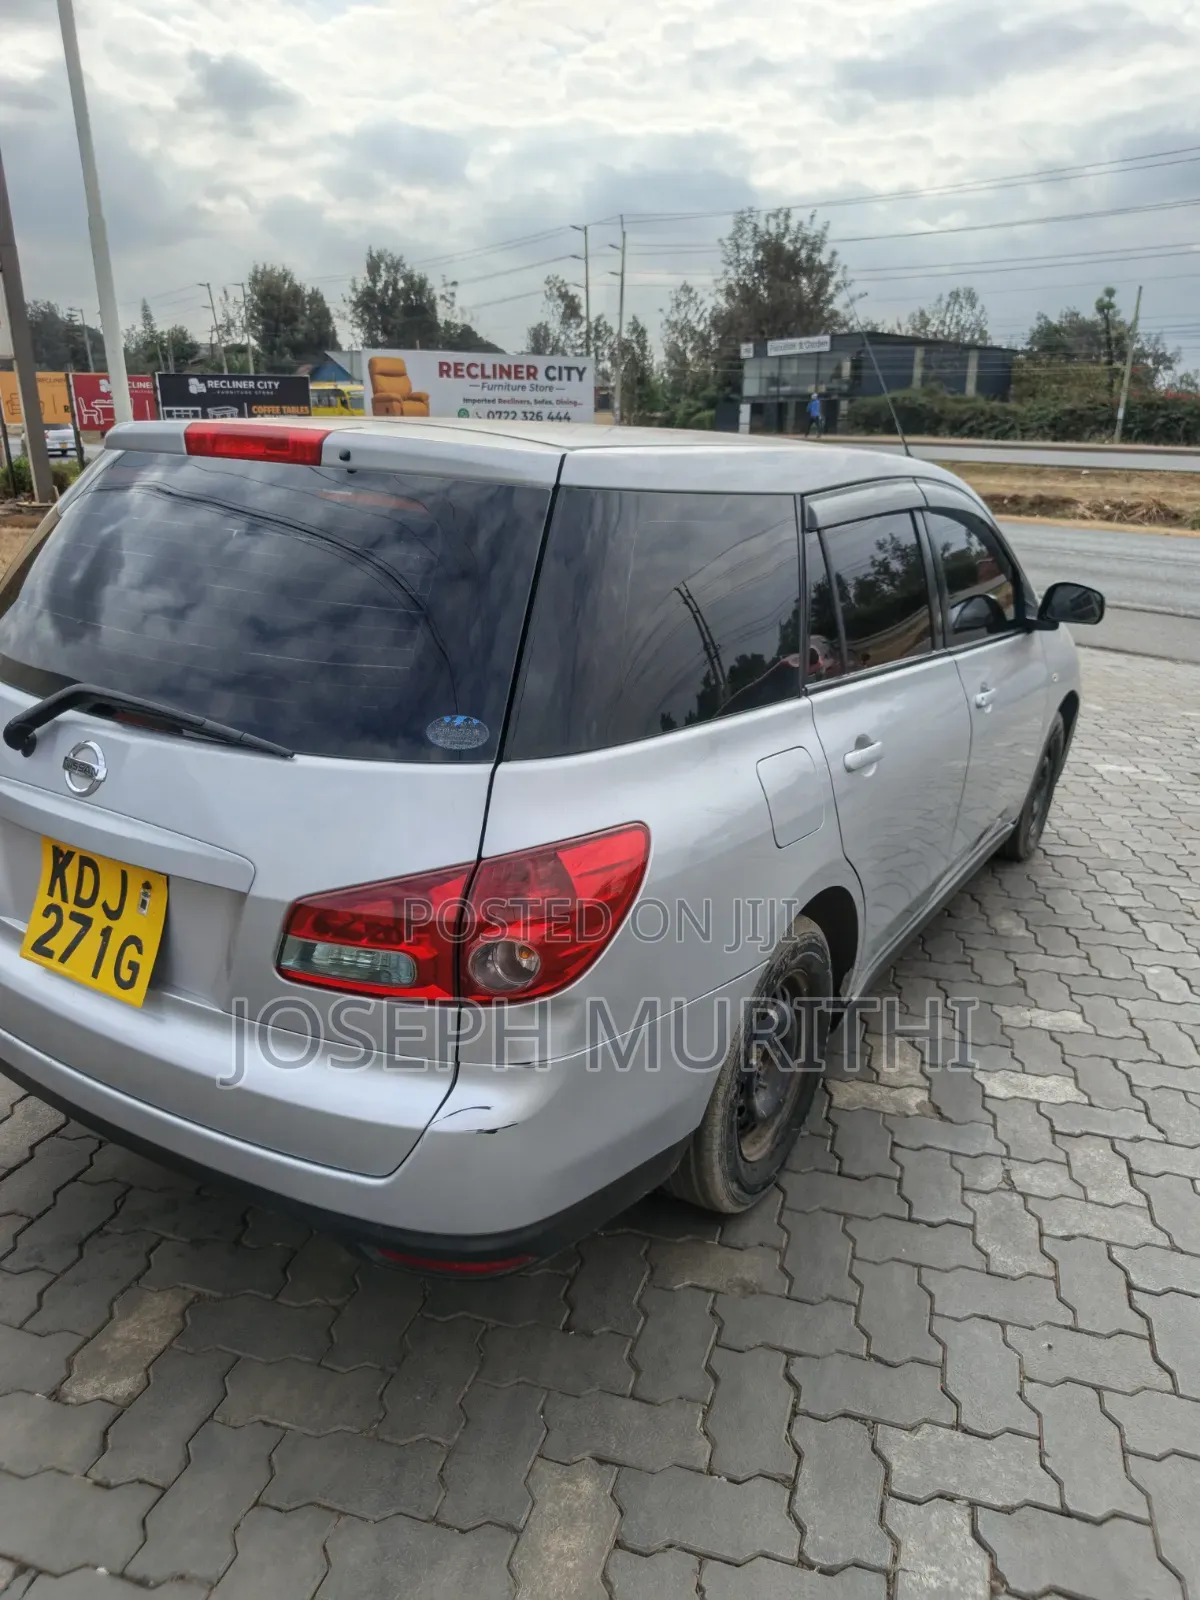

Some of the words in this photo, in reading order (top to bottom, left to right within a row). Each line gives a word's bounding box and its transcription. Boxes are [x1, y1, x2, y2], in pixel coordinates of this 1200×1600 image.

[438, 361, 538, 381] RECLINER
[544, 365, 587, 382] CITY
[207, 380, 256, 389] RECLINER
[257, 381, 280, 389] CITY
[481, 381, 527, 392] Furniture
[529, 383, 554, 393] Store
[462, 397, 496, 406] Imported
[251, 405, 281, 415] COFFEE
[282, 405, 310, 415] TABLES
[486, 410, 518, 420] 0722
[522, 411, 544, 422] 326
[547, 411, 571, 423] 444
[64, 757, 99, 778] NISSAN
[47, 845, 128, 921] KDJ
[31, 903, 144, 991] 271G
